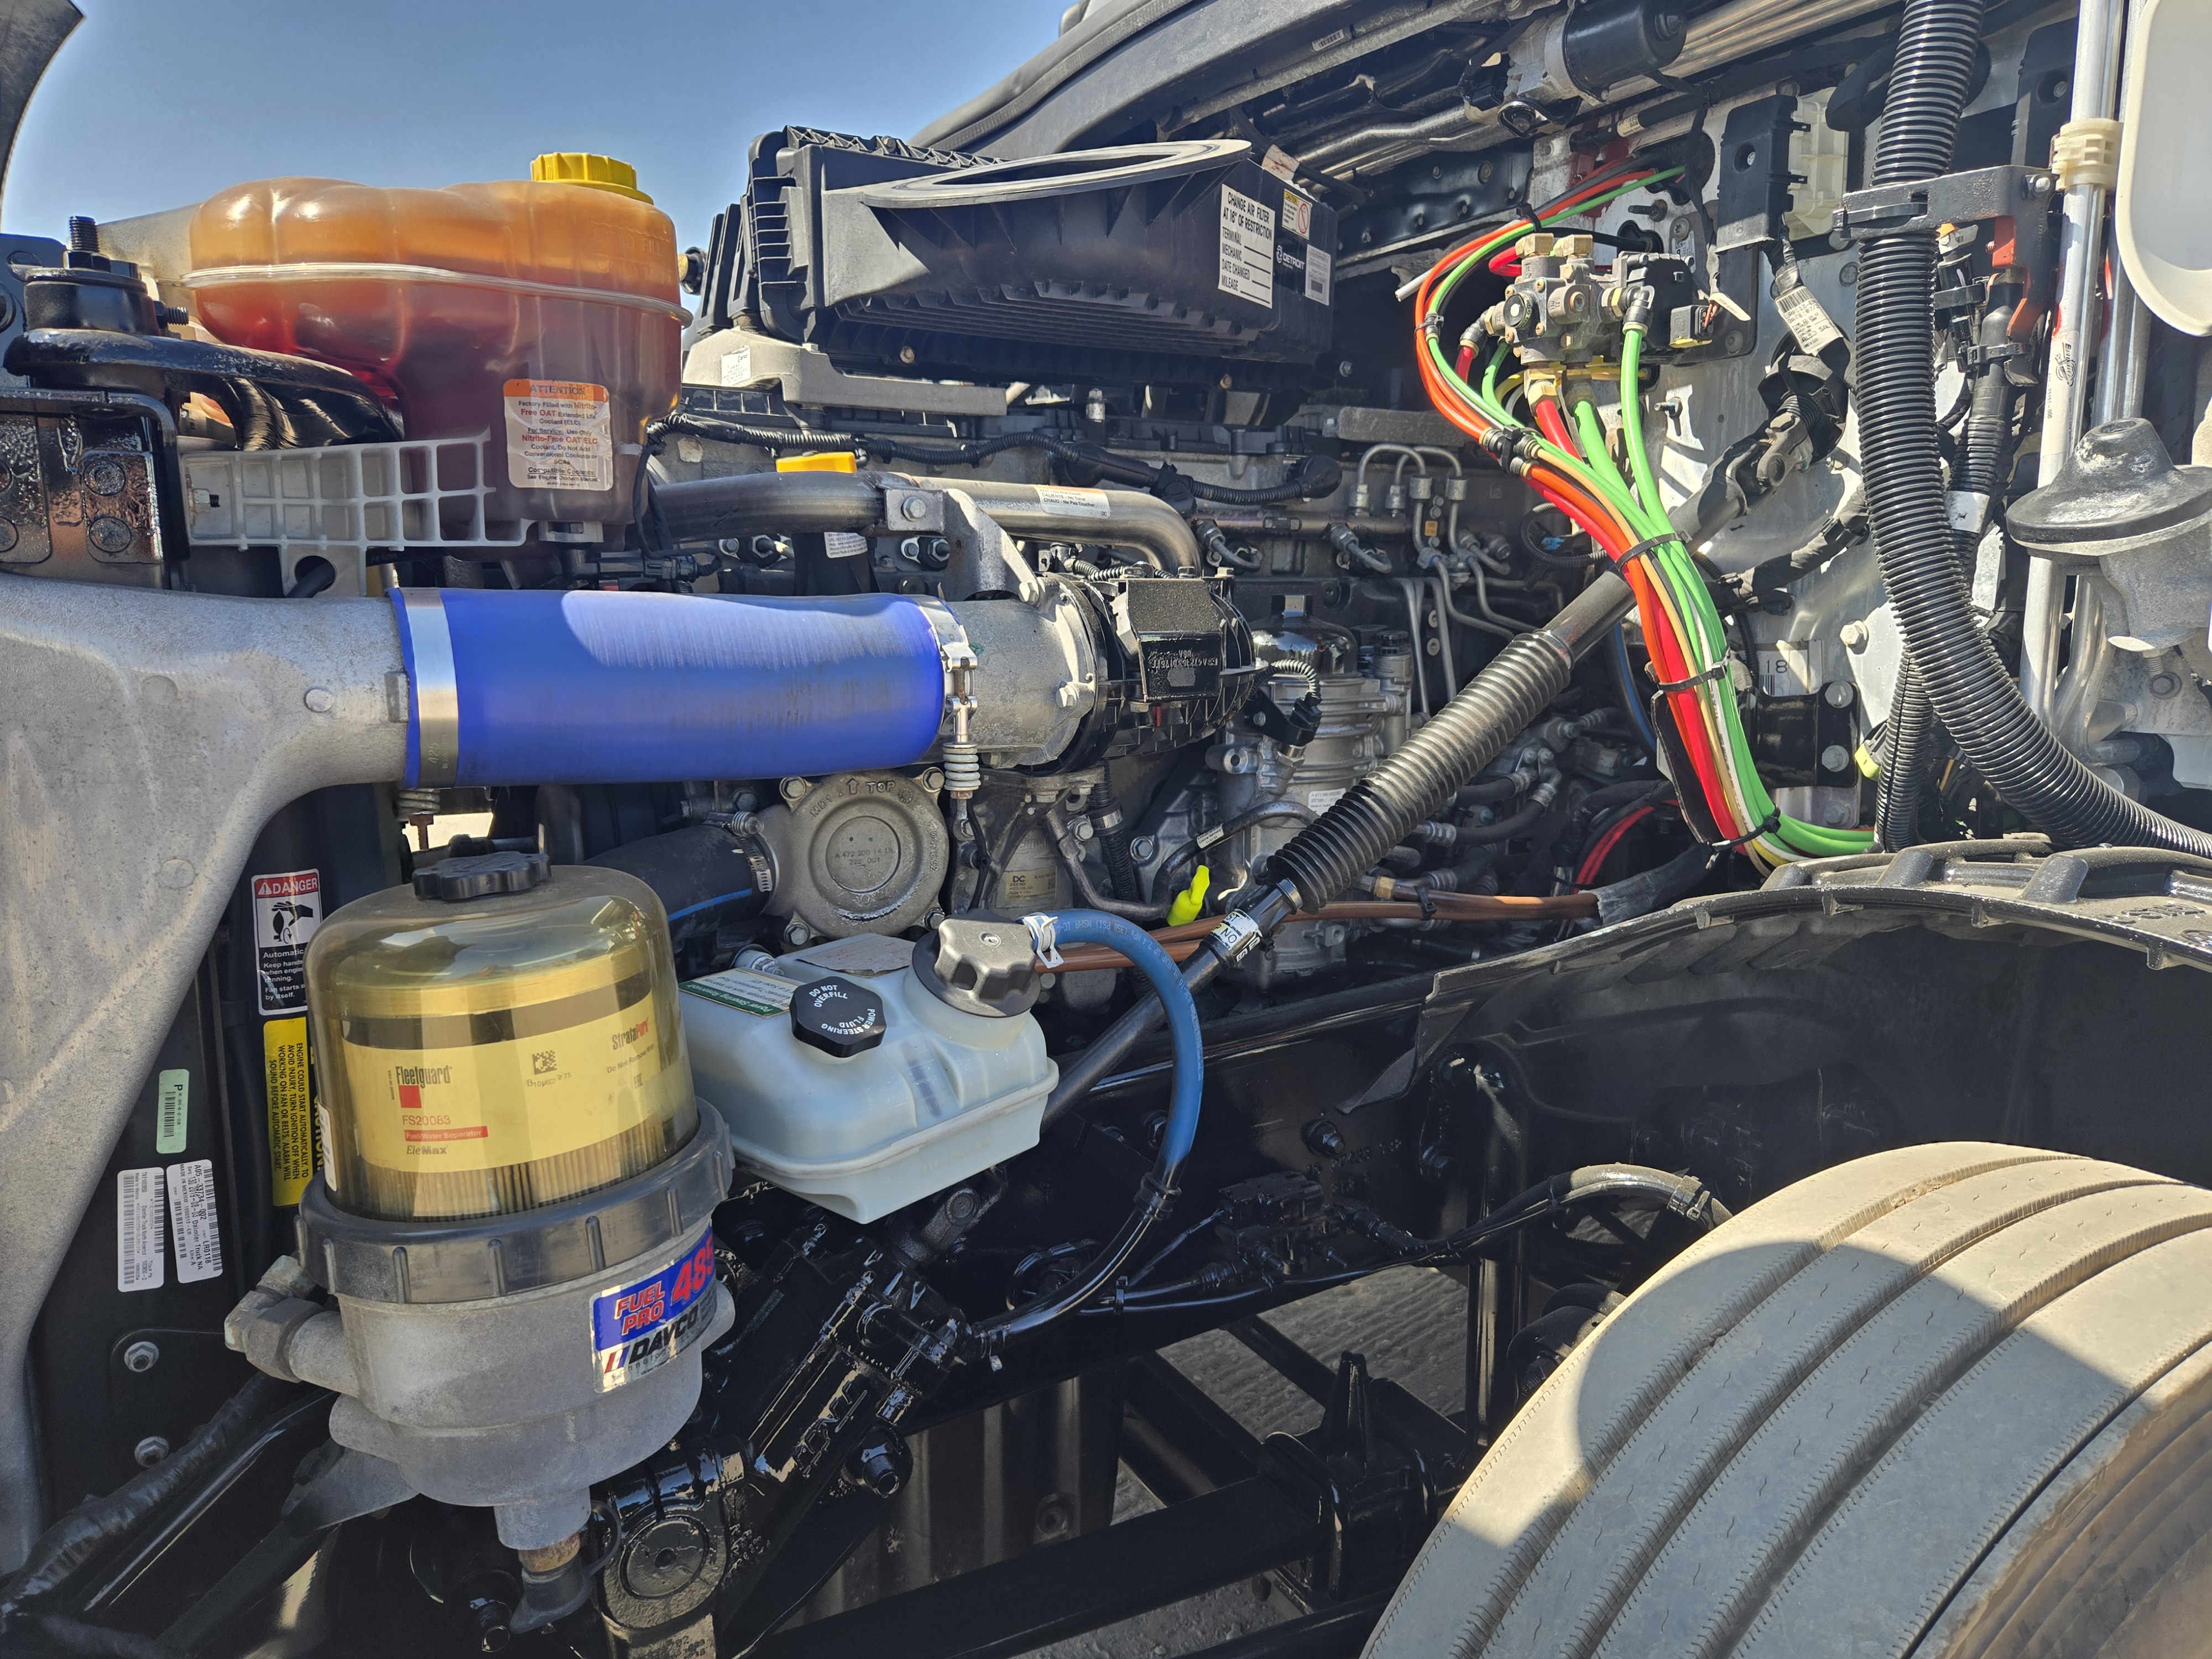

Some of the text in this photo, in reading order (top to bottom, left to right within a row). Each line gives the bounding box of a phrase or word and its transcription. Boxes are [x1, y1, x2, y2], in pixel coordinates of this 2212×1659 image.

[1228, 192, 1246, 211] CHANGE
[1257, 206, 1269, 223] FILTER
[1223, 207, 1228, 219] AT
[1239, 214, 1244, 227] OF
[1245, 218, 1272, 241] RESTRICTION
[593, 228, 635, 248] COLD
[1223, 227, 1242, 245] TERMINAL
[1222, 243, 1242, 261] MECHANIC
[1222, 259, 1250, 280] DATE CHANGED
[1282, 253, 1305, 270] DETROIT
[1222, 275, 1238, 291] MILEAGE
[530, 385, 586, 395] ATTENTION
[865, 780, 896, 794] TOP
[272, 878, 317, 894] DANGER
[687, 984, 773, 1013] Power Steering Reservoir
[809, 988, 821, 998] DO
[813, 991, 848, 1008] OVERFILL
[821, 1008, 876, 1035] POWER STEERING
[839, 1016, 864, 1028] FLUID
[278, 1045, 286, 1079] WORKING
[618, 1060, 628, 1069] Not
[269, 1060, 278, 1084] SOUND
[395, 1065, 451, 1089] Fleetguard
[279, 1081, 287, 1092] ON
[270, 1085, 279, 1110] BEFORE
[281, 1109, 288, 1119] OR
[402, 1115, 451, 1125] FS20083
[272, 1111, 280, 1151] AUTOMATIC
[444, 1130, 482, 1139] Separator
[283, 1142, 291, 1166] ALARM
[406, 1145, 447, 1155] EleMax
[301, 1168, 309, 1177] TO
[191, 1220, 201, 1243] Daimler
[194, 1244, 202, 1260] Truck
[202, 1240, 212, 1264] LR0118
[196, 1261, 203, 1270] NA
[614, 1280, 665, 1319] FUEL
[622, 1300, 664, 1336] PRO
[628, 1304, 698, 1365] DAVCO
